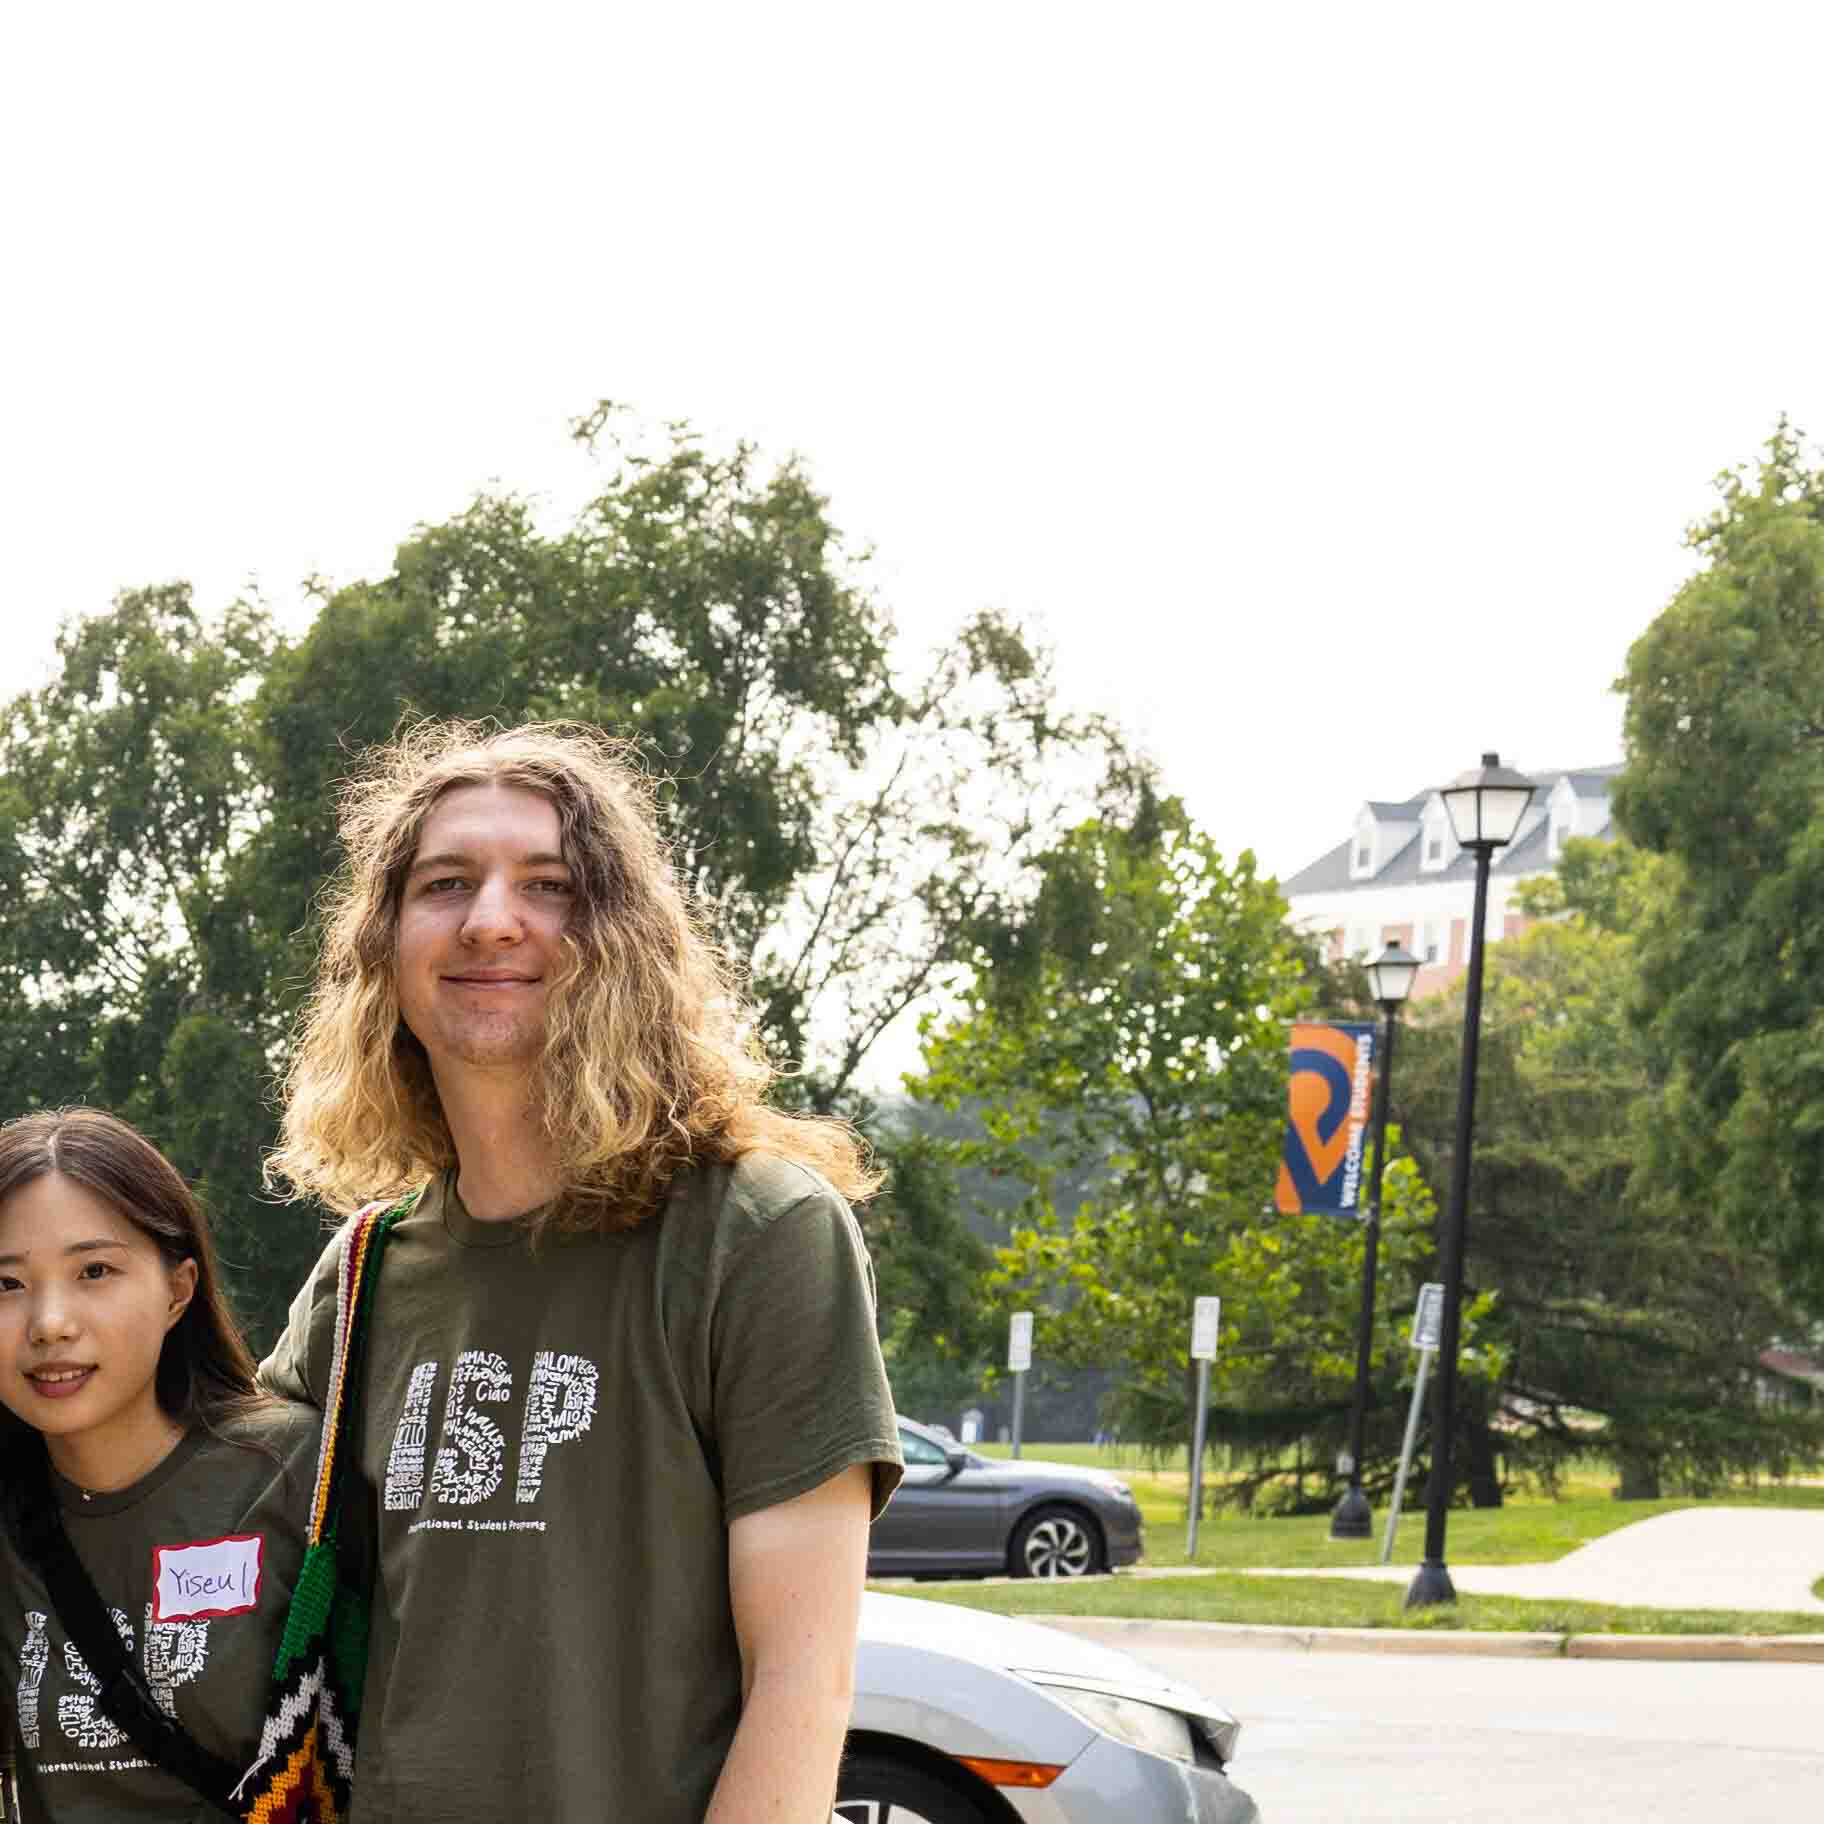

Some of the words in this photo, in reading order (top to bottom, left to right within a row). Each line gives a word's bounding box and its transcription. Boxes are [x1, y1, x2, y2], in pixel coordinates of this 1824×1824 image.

[384, 1350, 601, 1512] ISP
[466, 1520, 507, 1531] Student
[168, 1561, 247, 1598] Yiseul
